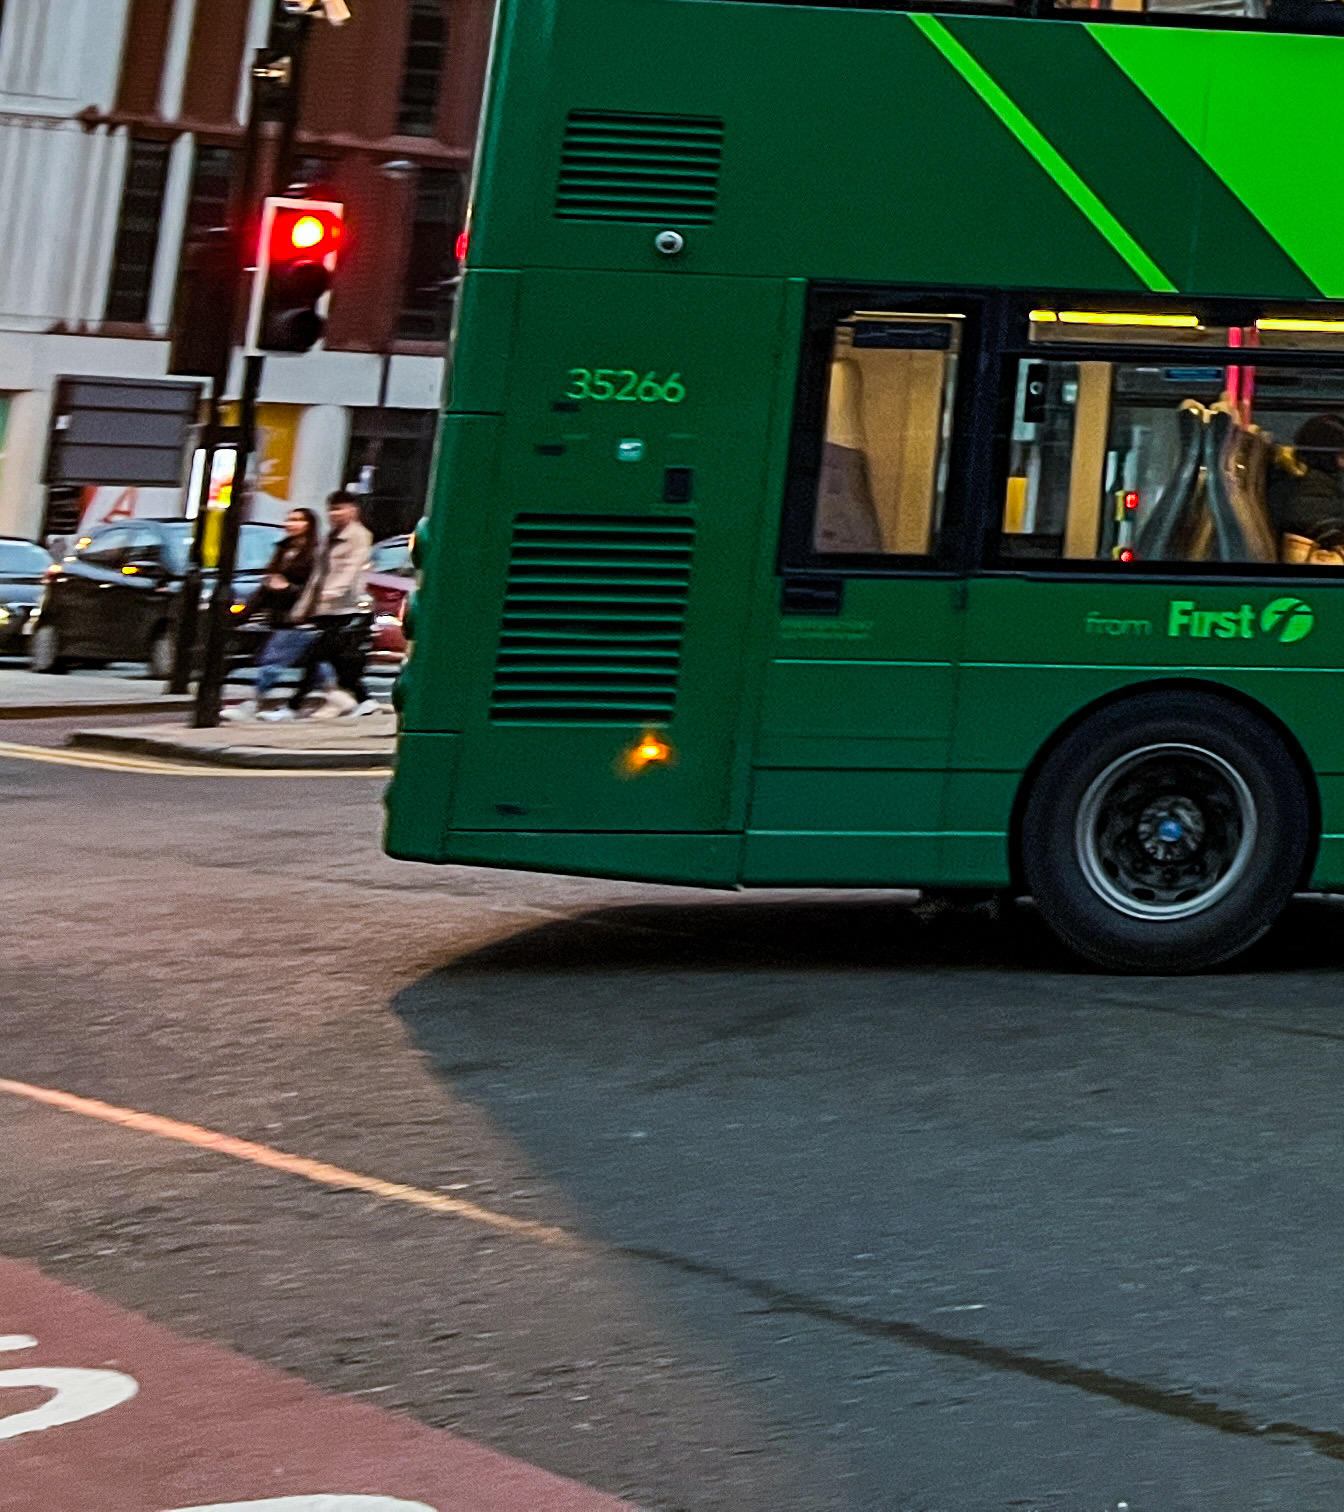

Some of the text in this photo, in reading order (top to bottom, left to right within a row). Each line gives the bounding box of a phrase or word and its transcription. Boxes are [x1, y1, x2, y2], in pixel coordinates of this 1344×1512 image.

[566, 368, 686, 402] 35266
[1085, 600, 1255, 639] from First
